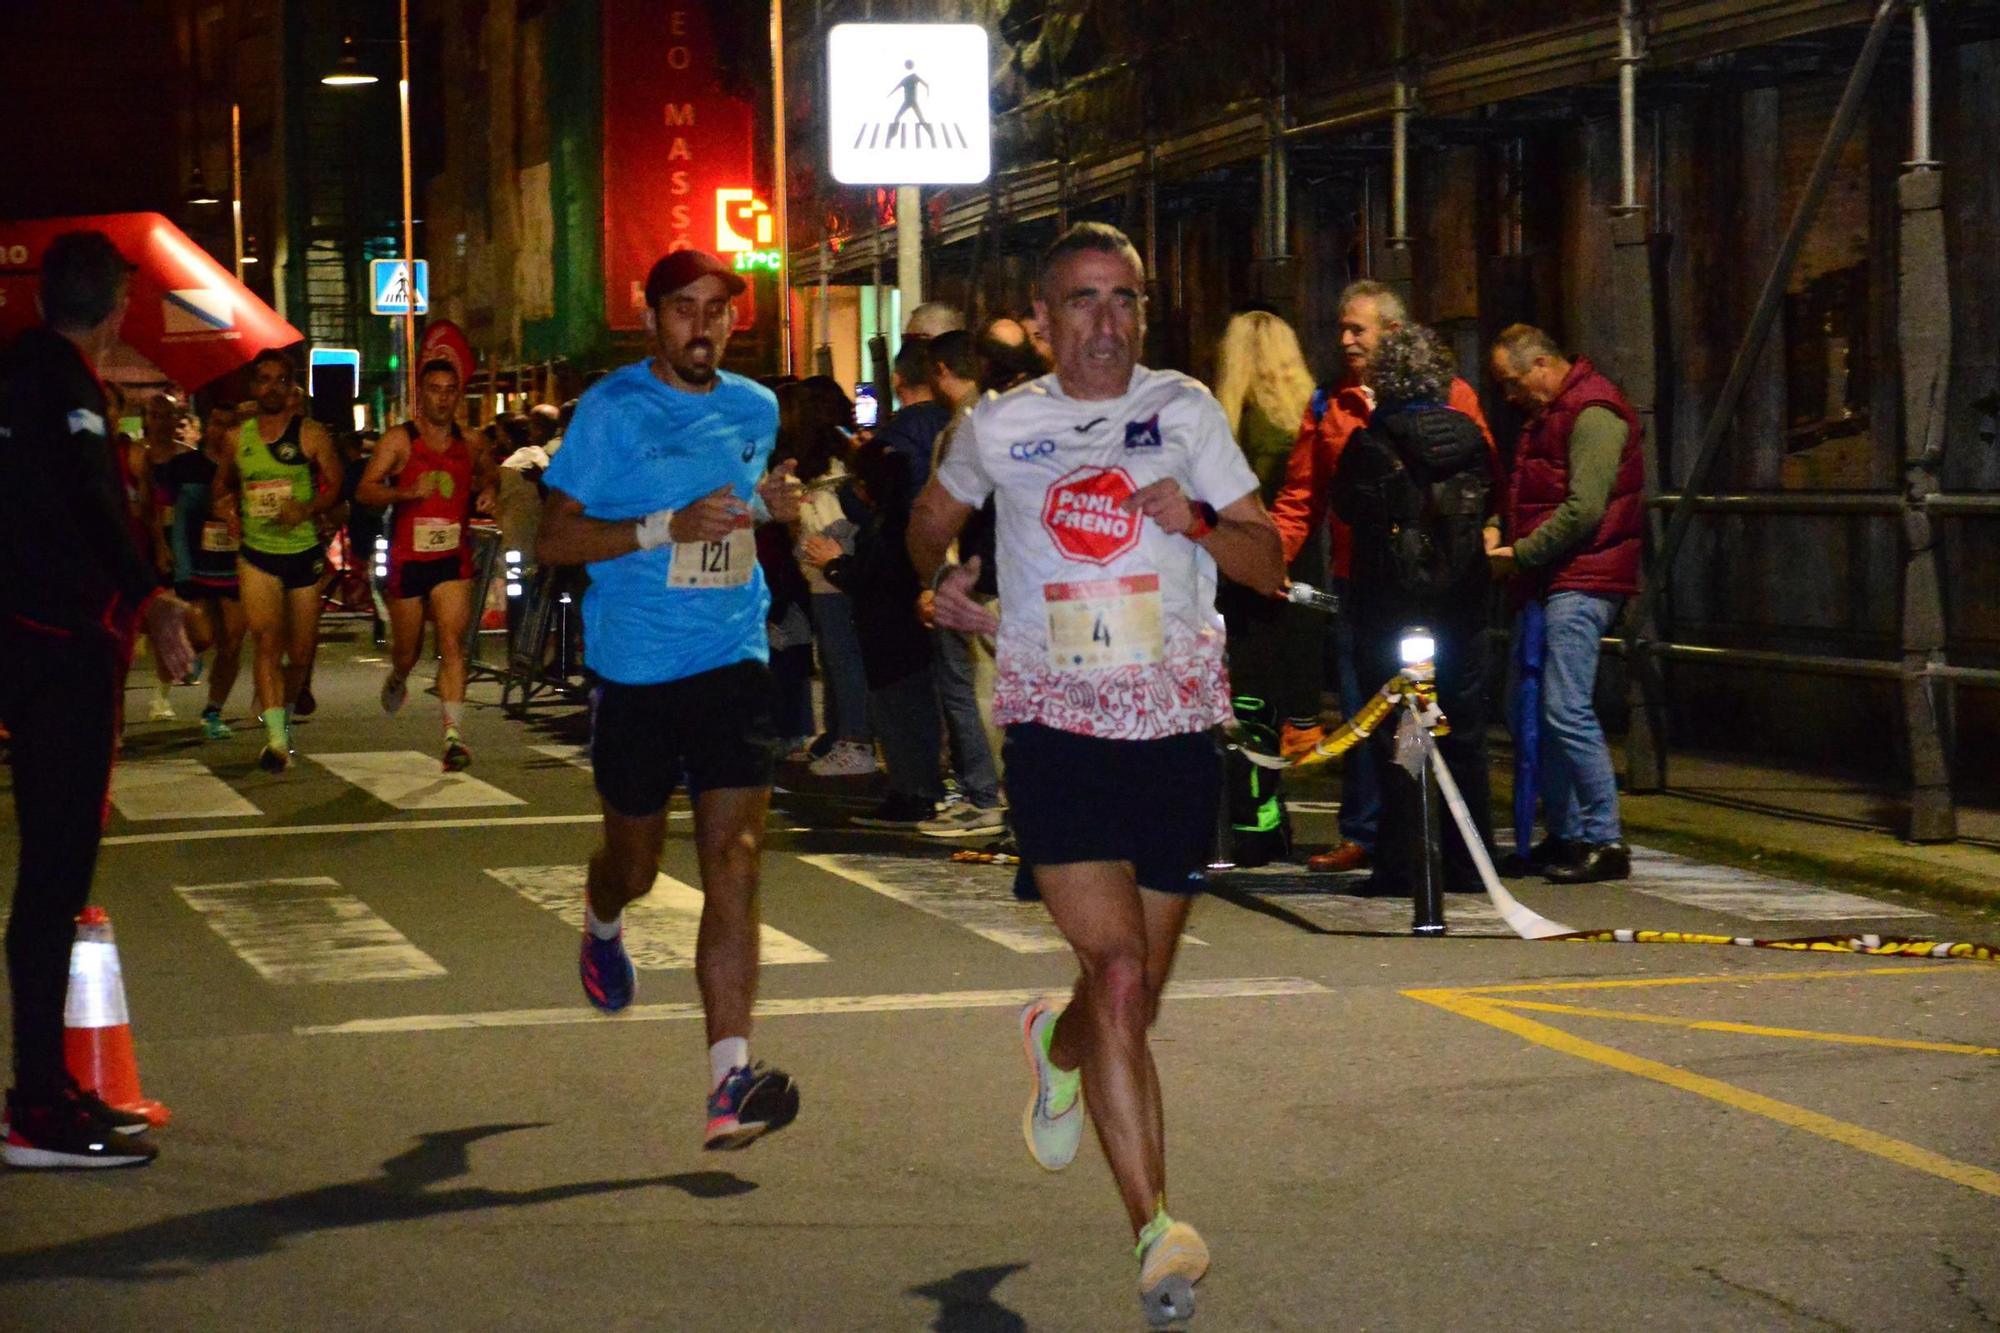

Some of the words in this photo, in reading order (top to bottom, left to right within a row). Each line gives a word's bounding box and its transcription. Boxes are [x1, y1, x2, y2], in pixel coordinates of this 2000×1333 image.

[1052, 510, 1129, 538] FRENO
[702, 541, 730, 572] 121
[1092, 610, 1111, 648] 4
